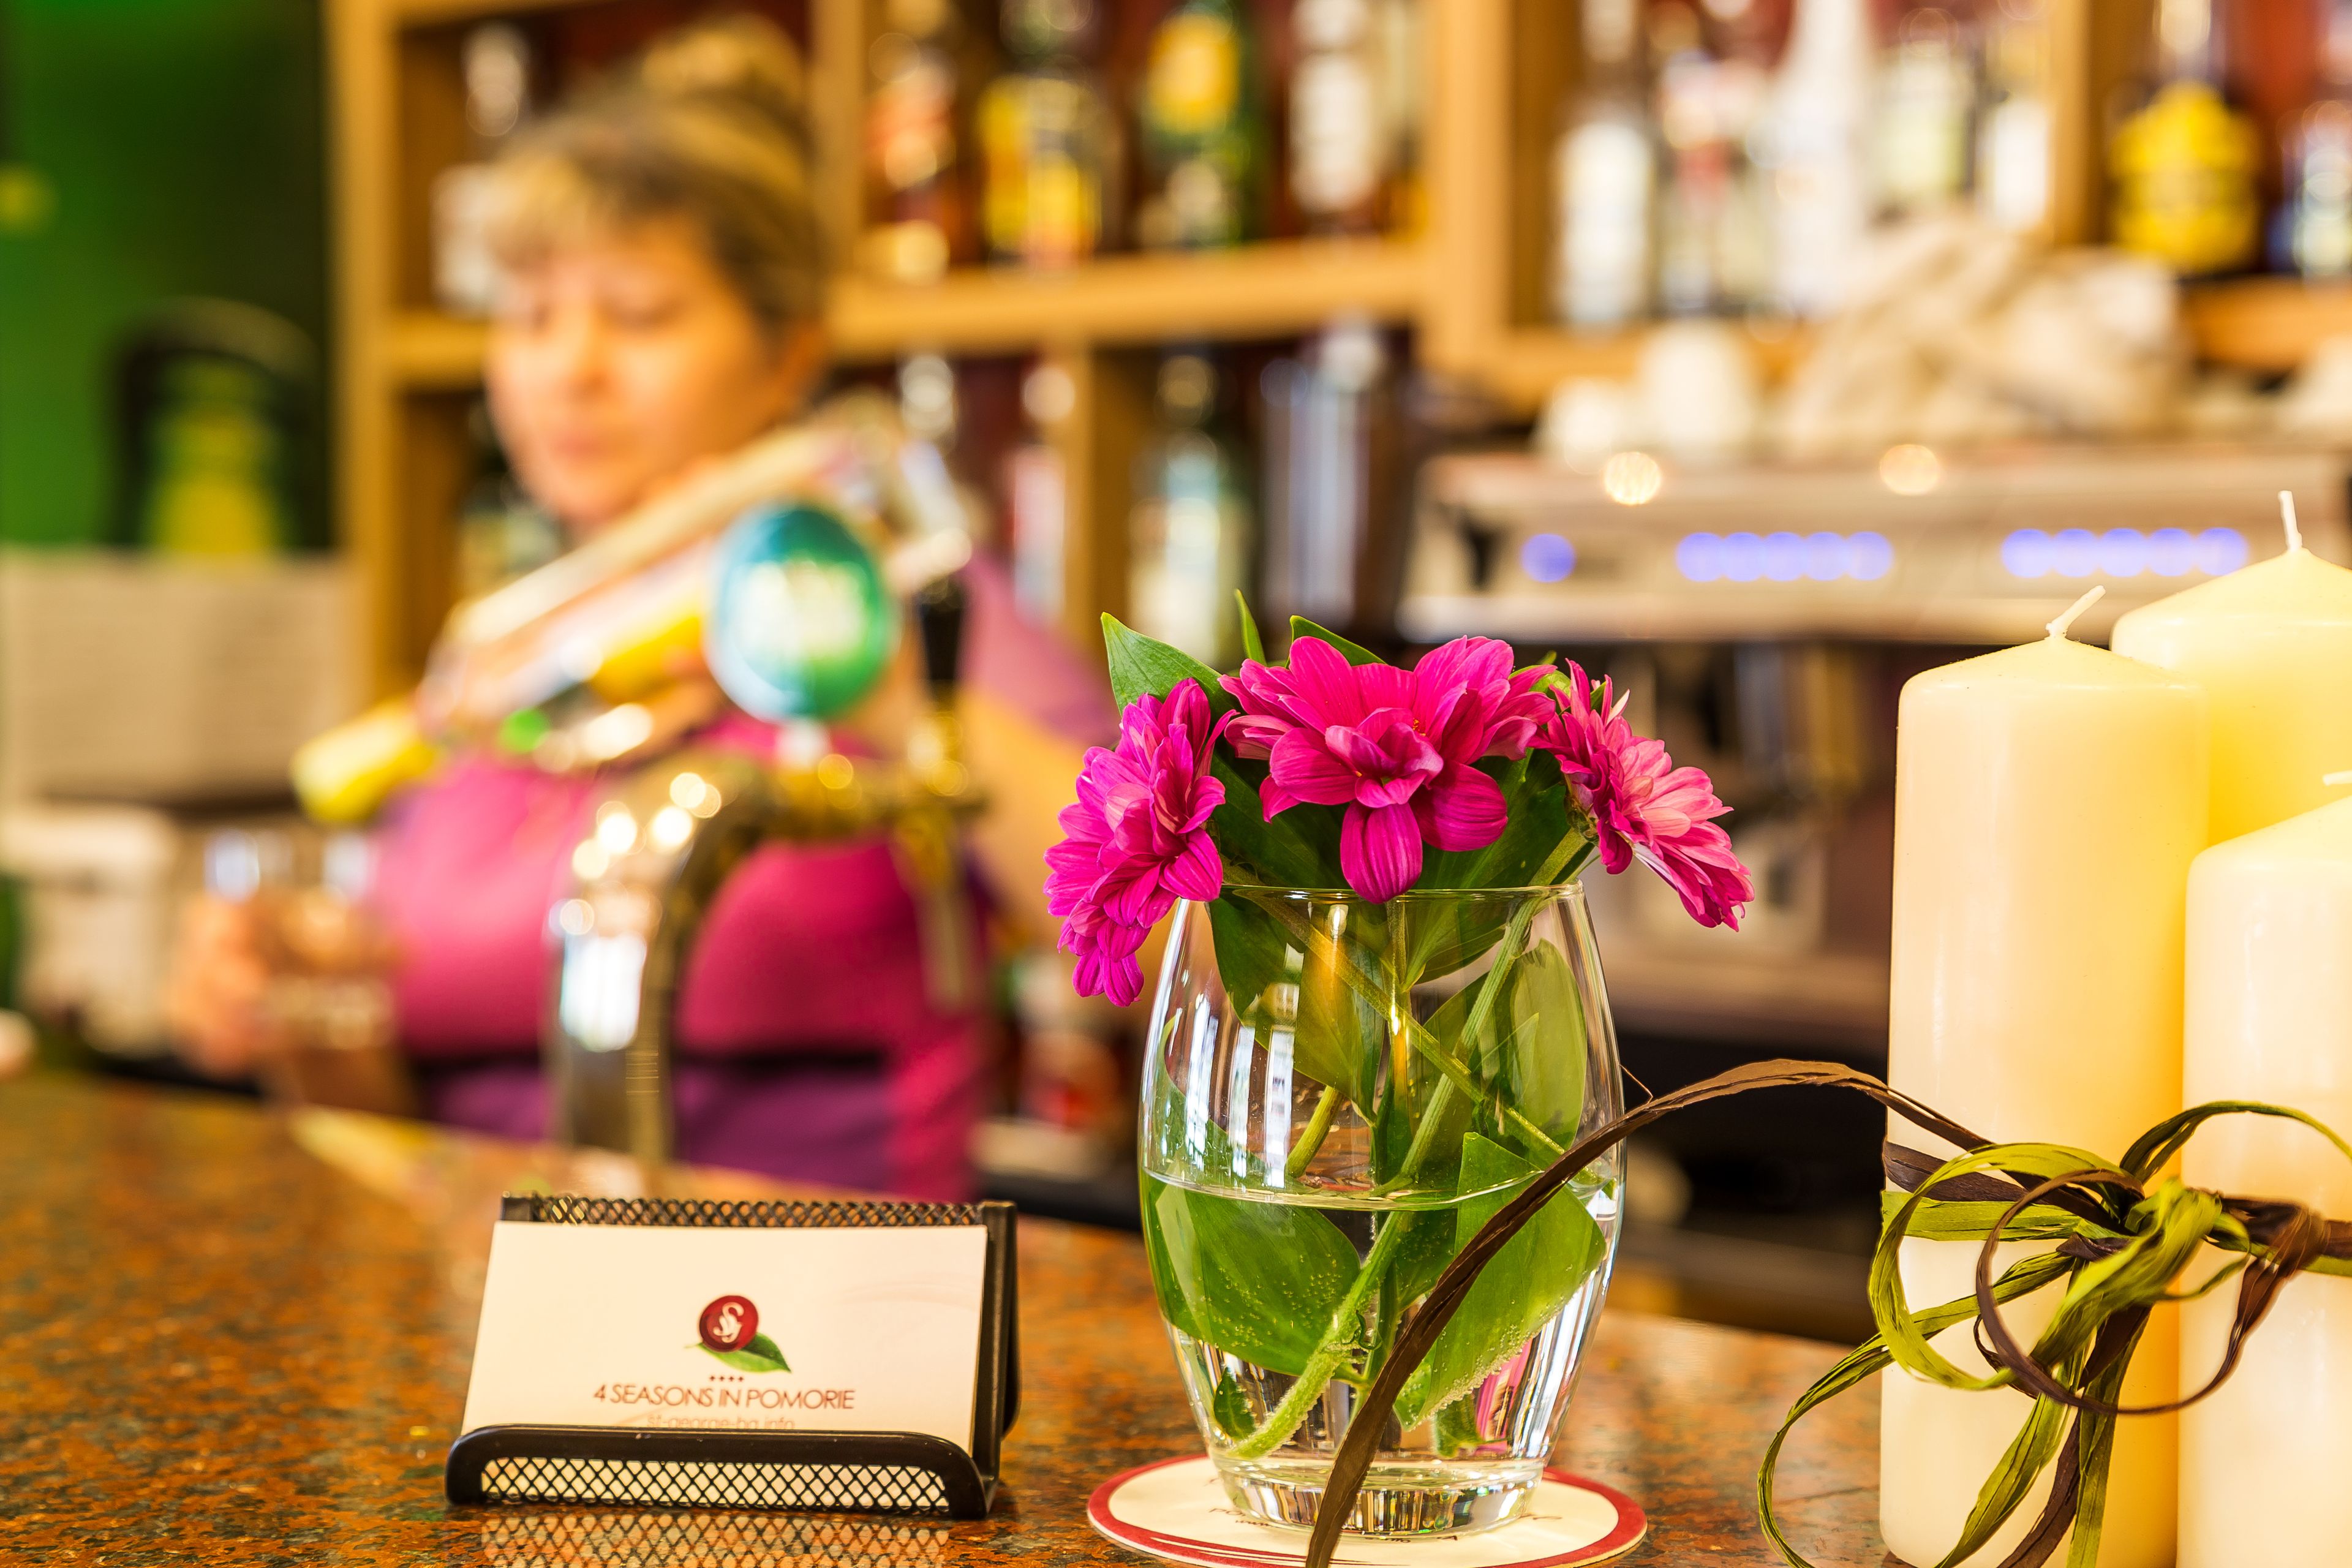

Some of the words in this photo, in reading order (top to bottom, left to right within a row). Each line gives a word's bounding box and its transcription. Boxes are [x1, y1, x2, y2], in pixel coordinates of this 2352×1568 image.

[594, 1384, 606, 1403] 4
[609, 1384, 714, 1408] SEASONS
[718, 1387, 742, 1407] IN
[746, 1389, 856, 1409] POMORIE
